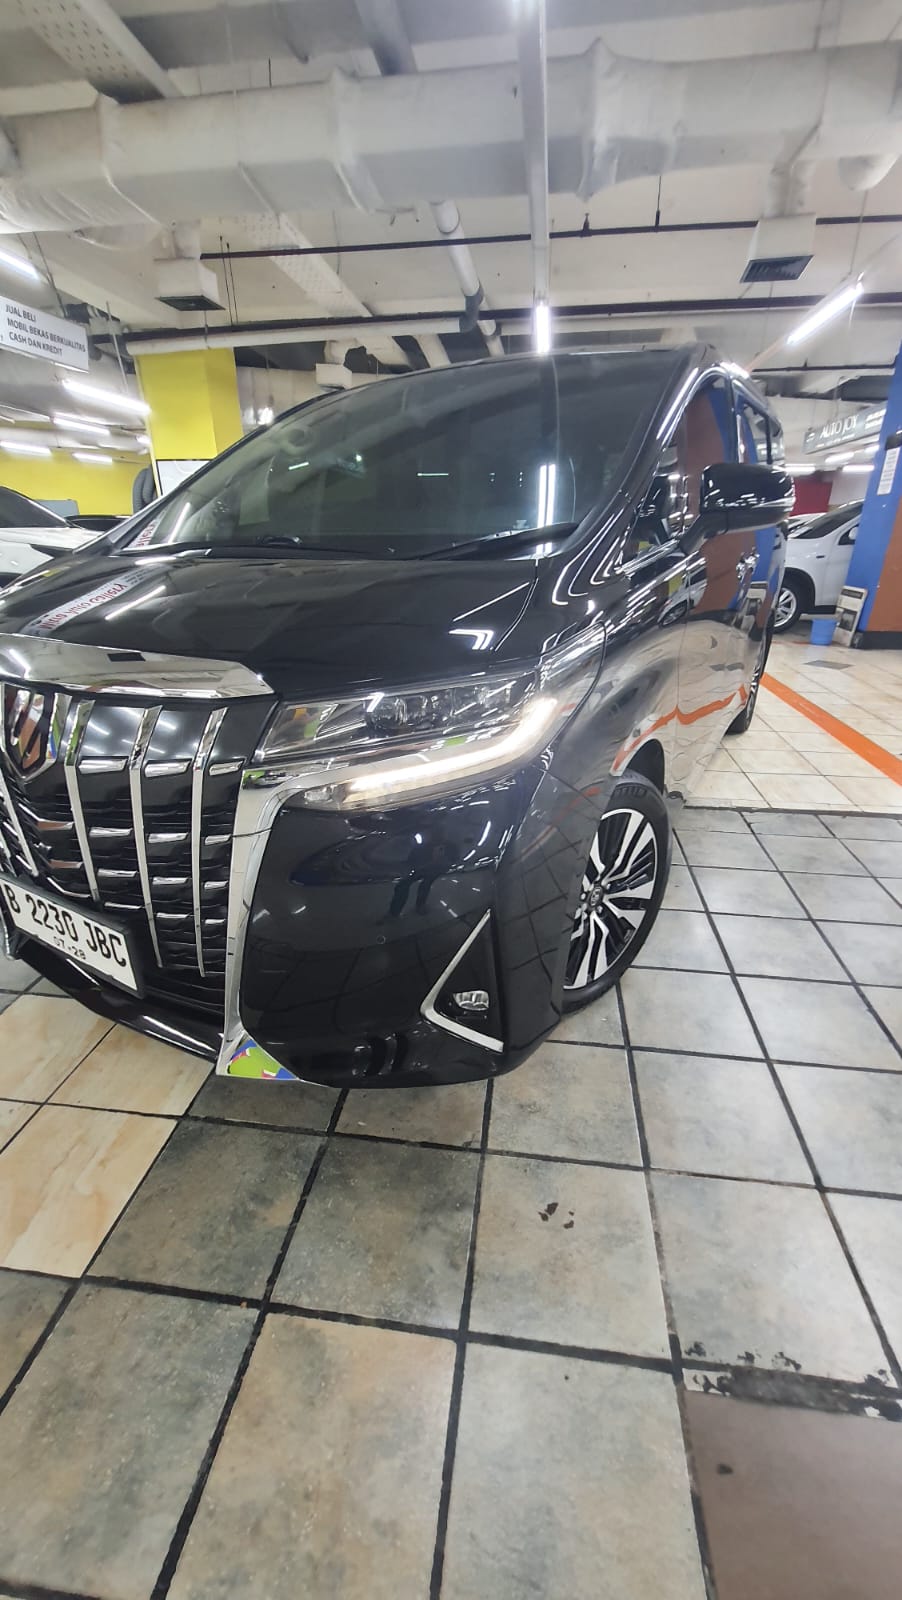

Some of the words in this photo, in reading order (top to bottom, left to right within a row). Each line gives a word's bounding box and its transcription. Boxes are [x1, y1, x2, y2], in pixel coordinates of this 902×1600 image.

[6, 304, 22, 317] JUAL
[22, 311, 36, 323] BELI
[7, 317, 28, 333] MOBIL
[29, 326, 49, 339] BEKAS
[49, 332, 86, 352] BERKUALITAS
[9, 331, 27, 344] CASH
[27, 337, 41, 350] DAN
[42, 343, 63, 356] KREDIT
[820, 420, 842, 438] AUTO
[842, 414, 859, 434] JOY
[4, 884, 21, 914] B
[26, 894, 78, 942] 2230
[83, 919, 127, 967] JBC
